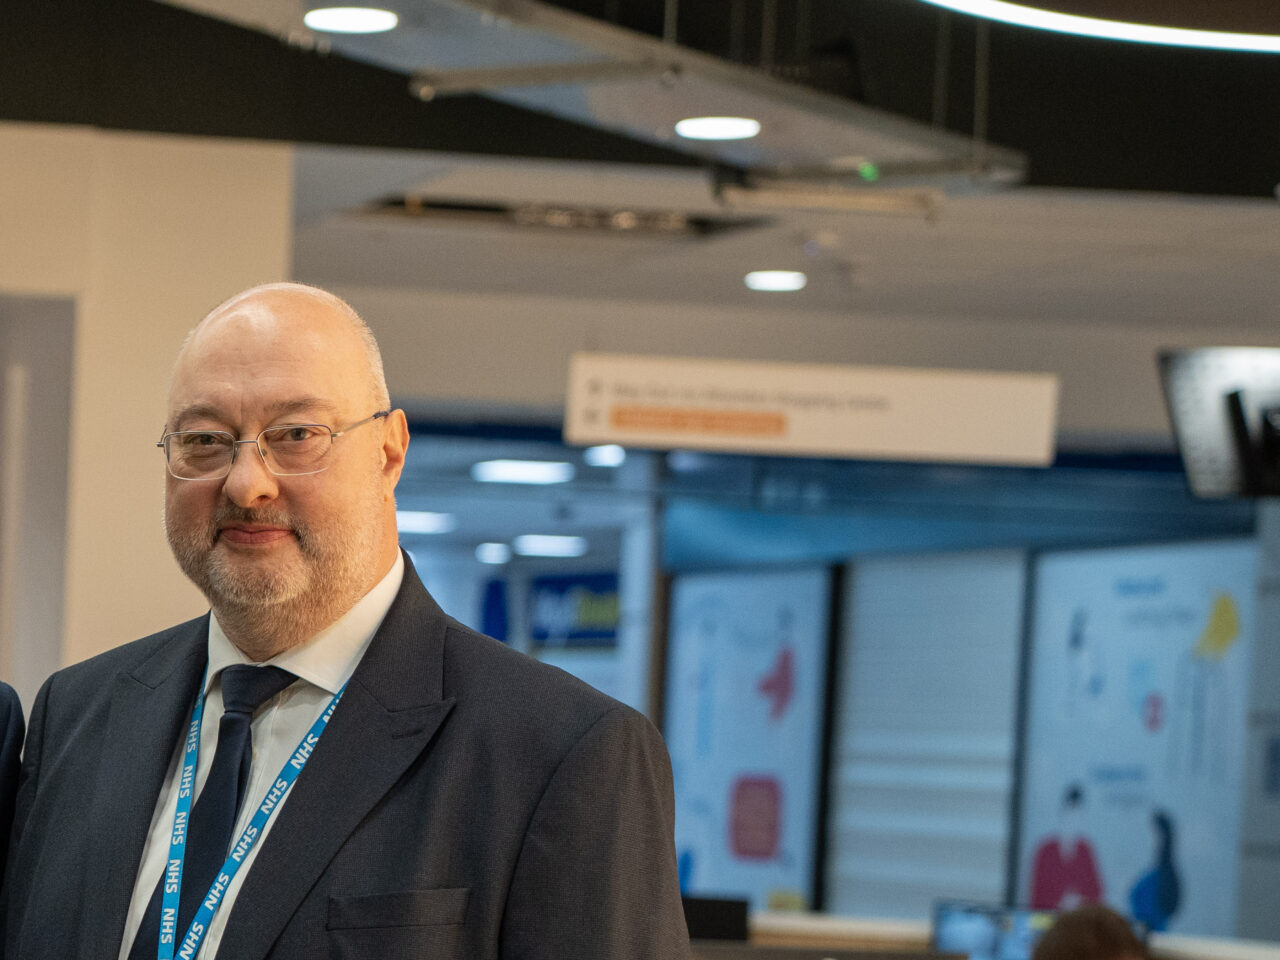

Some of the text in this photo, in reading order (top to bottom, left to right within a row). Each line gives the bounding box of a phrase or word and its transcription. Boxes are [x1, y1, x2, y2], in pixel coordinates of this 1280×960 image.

[187, 719, 199, 753] NHS
[290, 733, 319, 769] NHS
[180, 765, 193, 799] NHS
[260, 777, 288, 814] NHS
[172, 811, 187, 846] NHS
[232, 824, 258, 862] NHS
[166, 859, 181, 894] NHS
[204, 872, 230, 911] NHS
[161, 908, 175, 944] NHS
[179, 921, 204, 960] NHS
